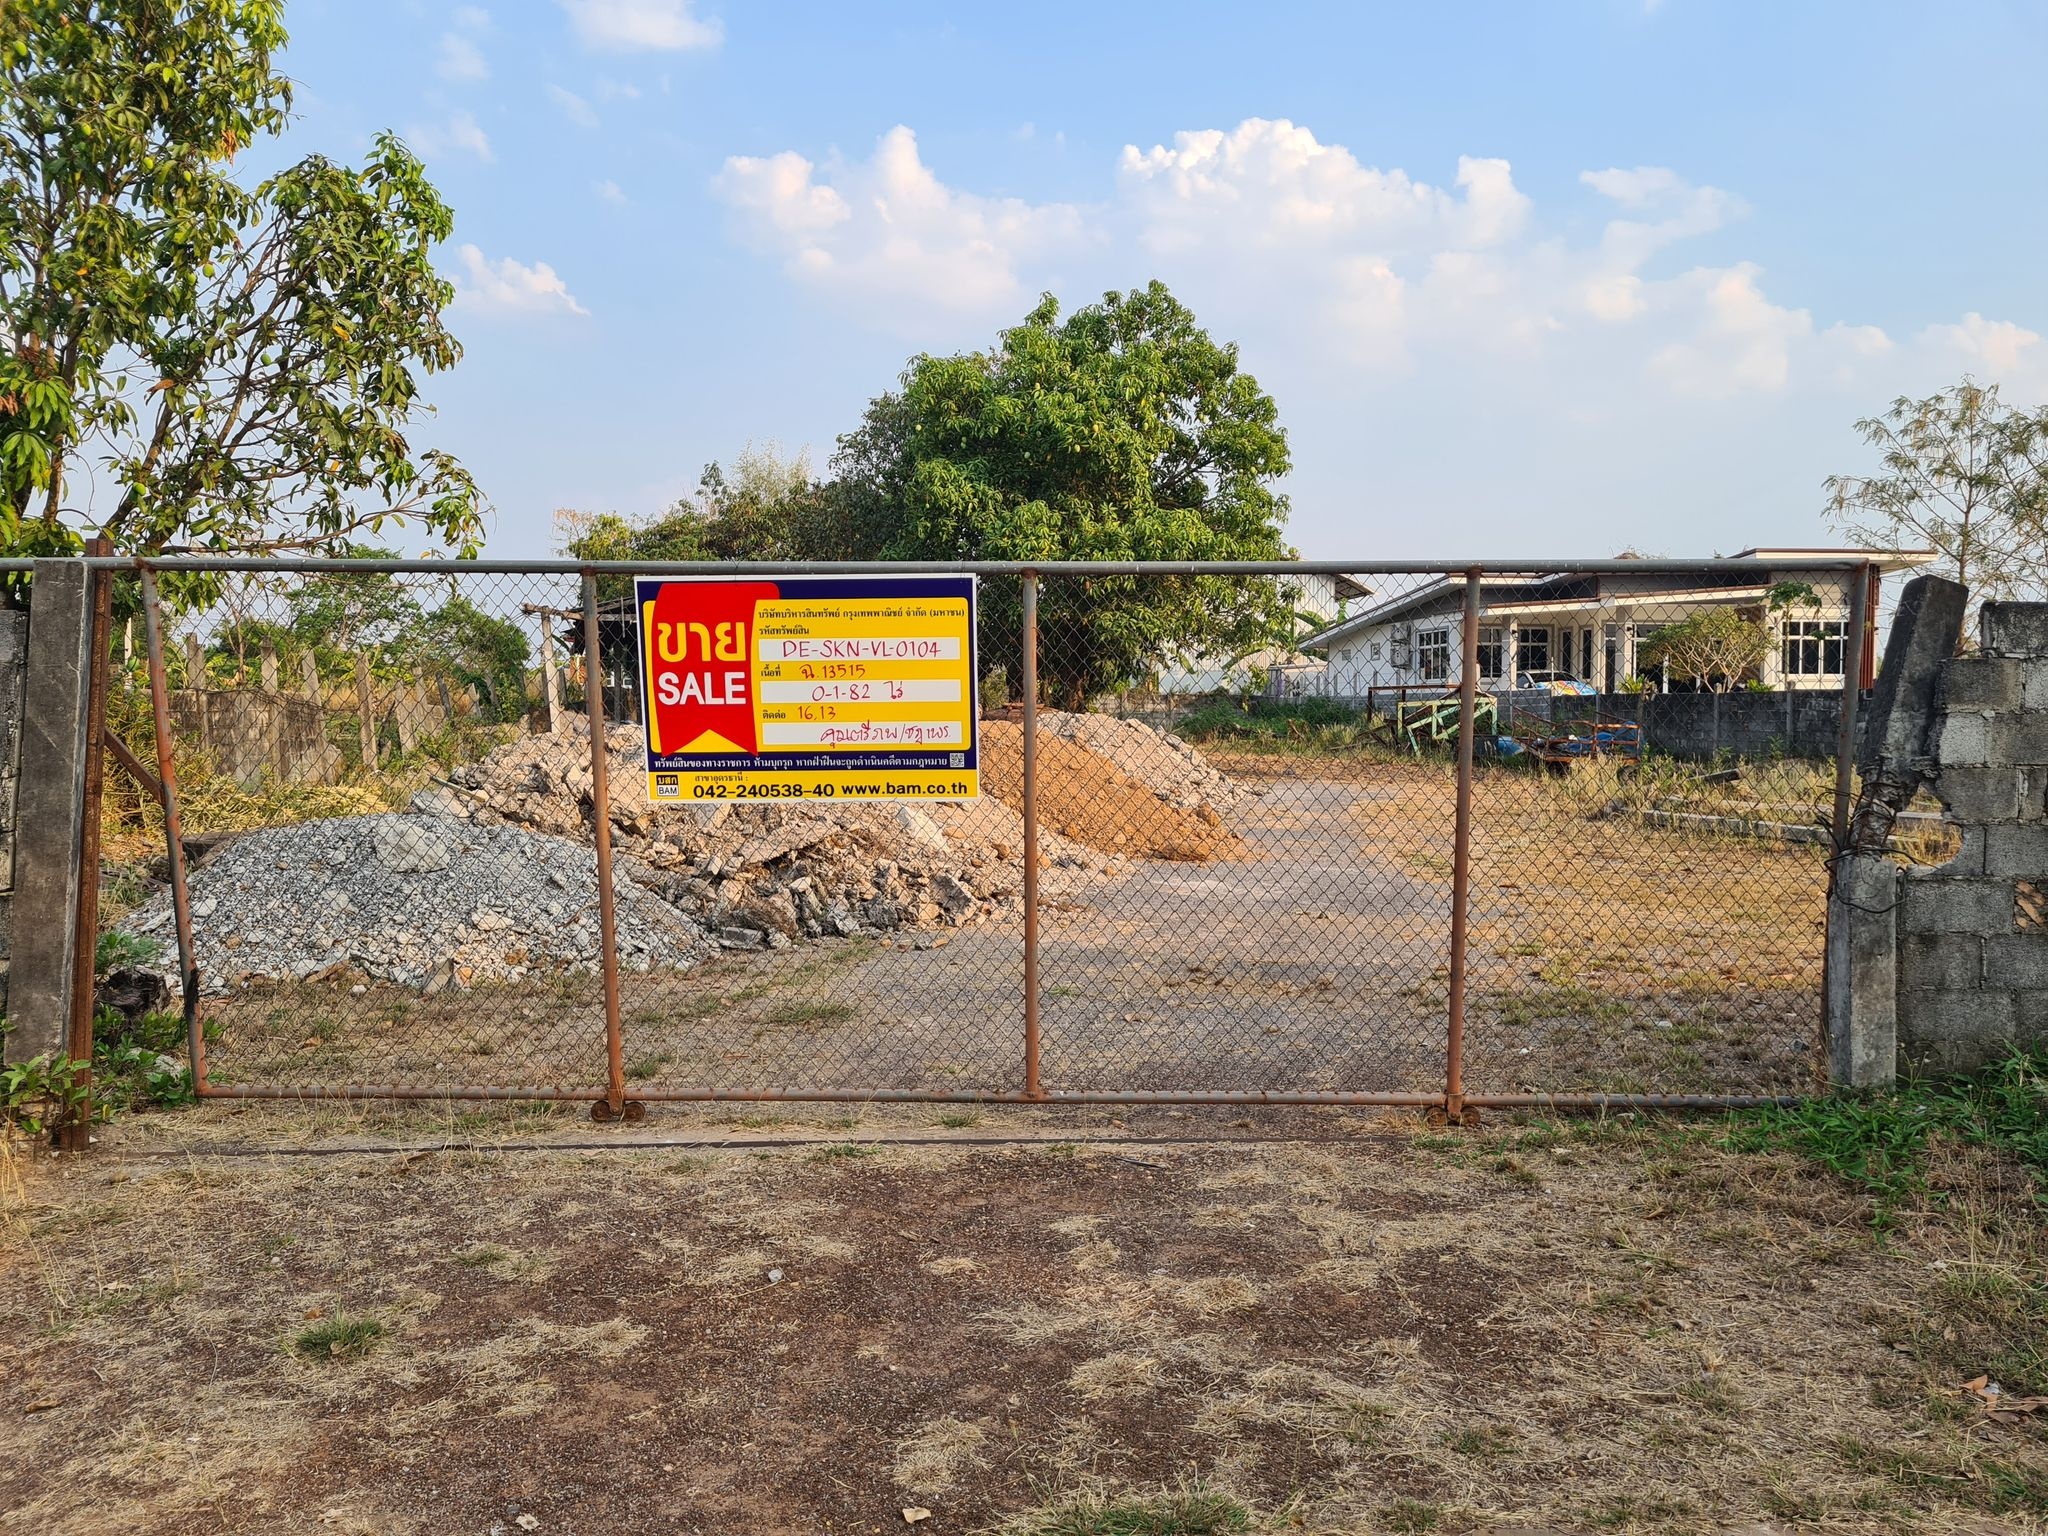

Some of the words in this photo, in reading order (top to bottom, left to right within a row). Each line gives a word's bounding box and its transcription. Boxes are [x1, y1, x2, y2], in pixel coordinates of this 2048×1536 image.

[758, 608, 841, 619] บริษัทบริหารสินทรัพย์
[842, 607, 903, 620] กรุงเทพพาณิชย์
[906, 607, 927, 618] จำกัด
[929, 608, 965, 617] (มหาชน)
[758, 623, 810, 635] รหัสทรัพย์สิน
[657, 621, 747, 663] ขาย
[760, 664, 782, 677] เนื้อที่
[658, 671, 747, 706] SALE
[762, 709, 787, 720] ติดต่อ
[654, 757, 751, 769] ทรัพย์สินของทางราชการ
[753, 758, 793, 771] ห้ามบุกรุก
[796, 754, 948, 770] หากฝ่าฝืนจะถูกดำเนินคดีตามกฎหมาย
[656, 776, 678, 785] บสก
[658, 785, 678, 795] BAM
[692, 783, 835, 798] 042-240538-40
[841, 782, 968, 795] www.bam.co.th
